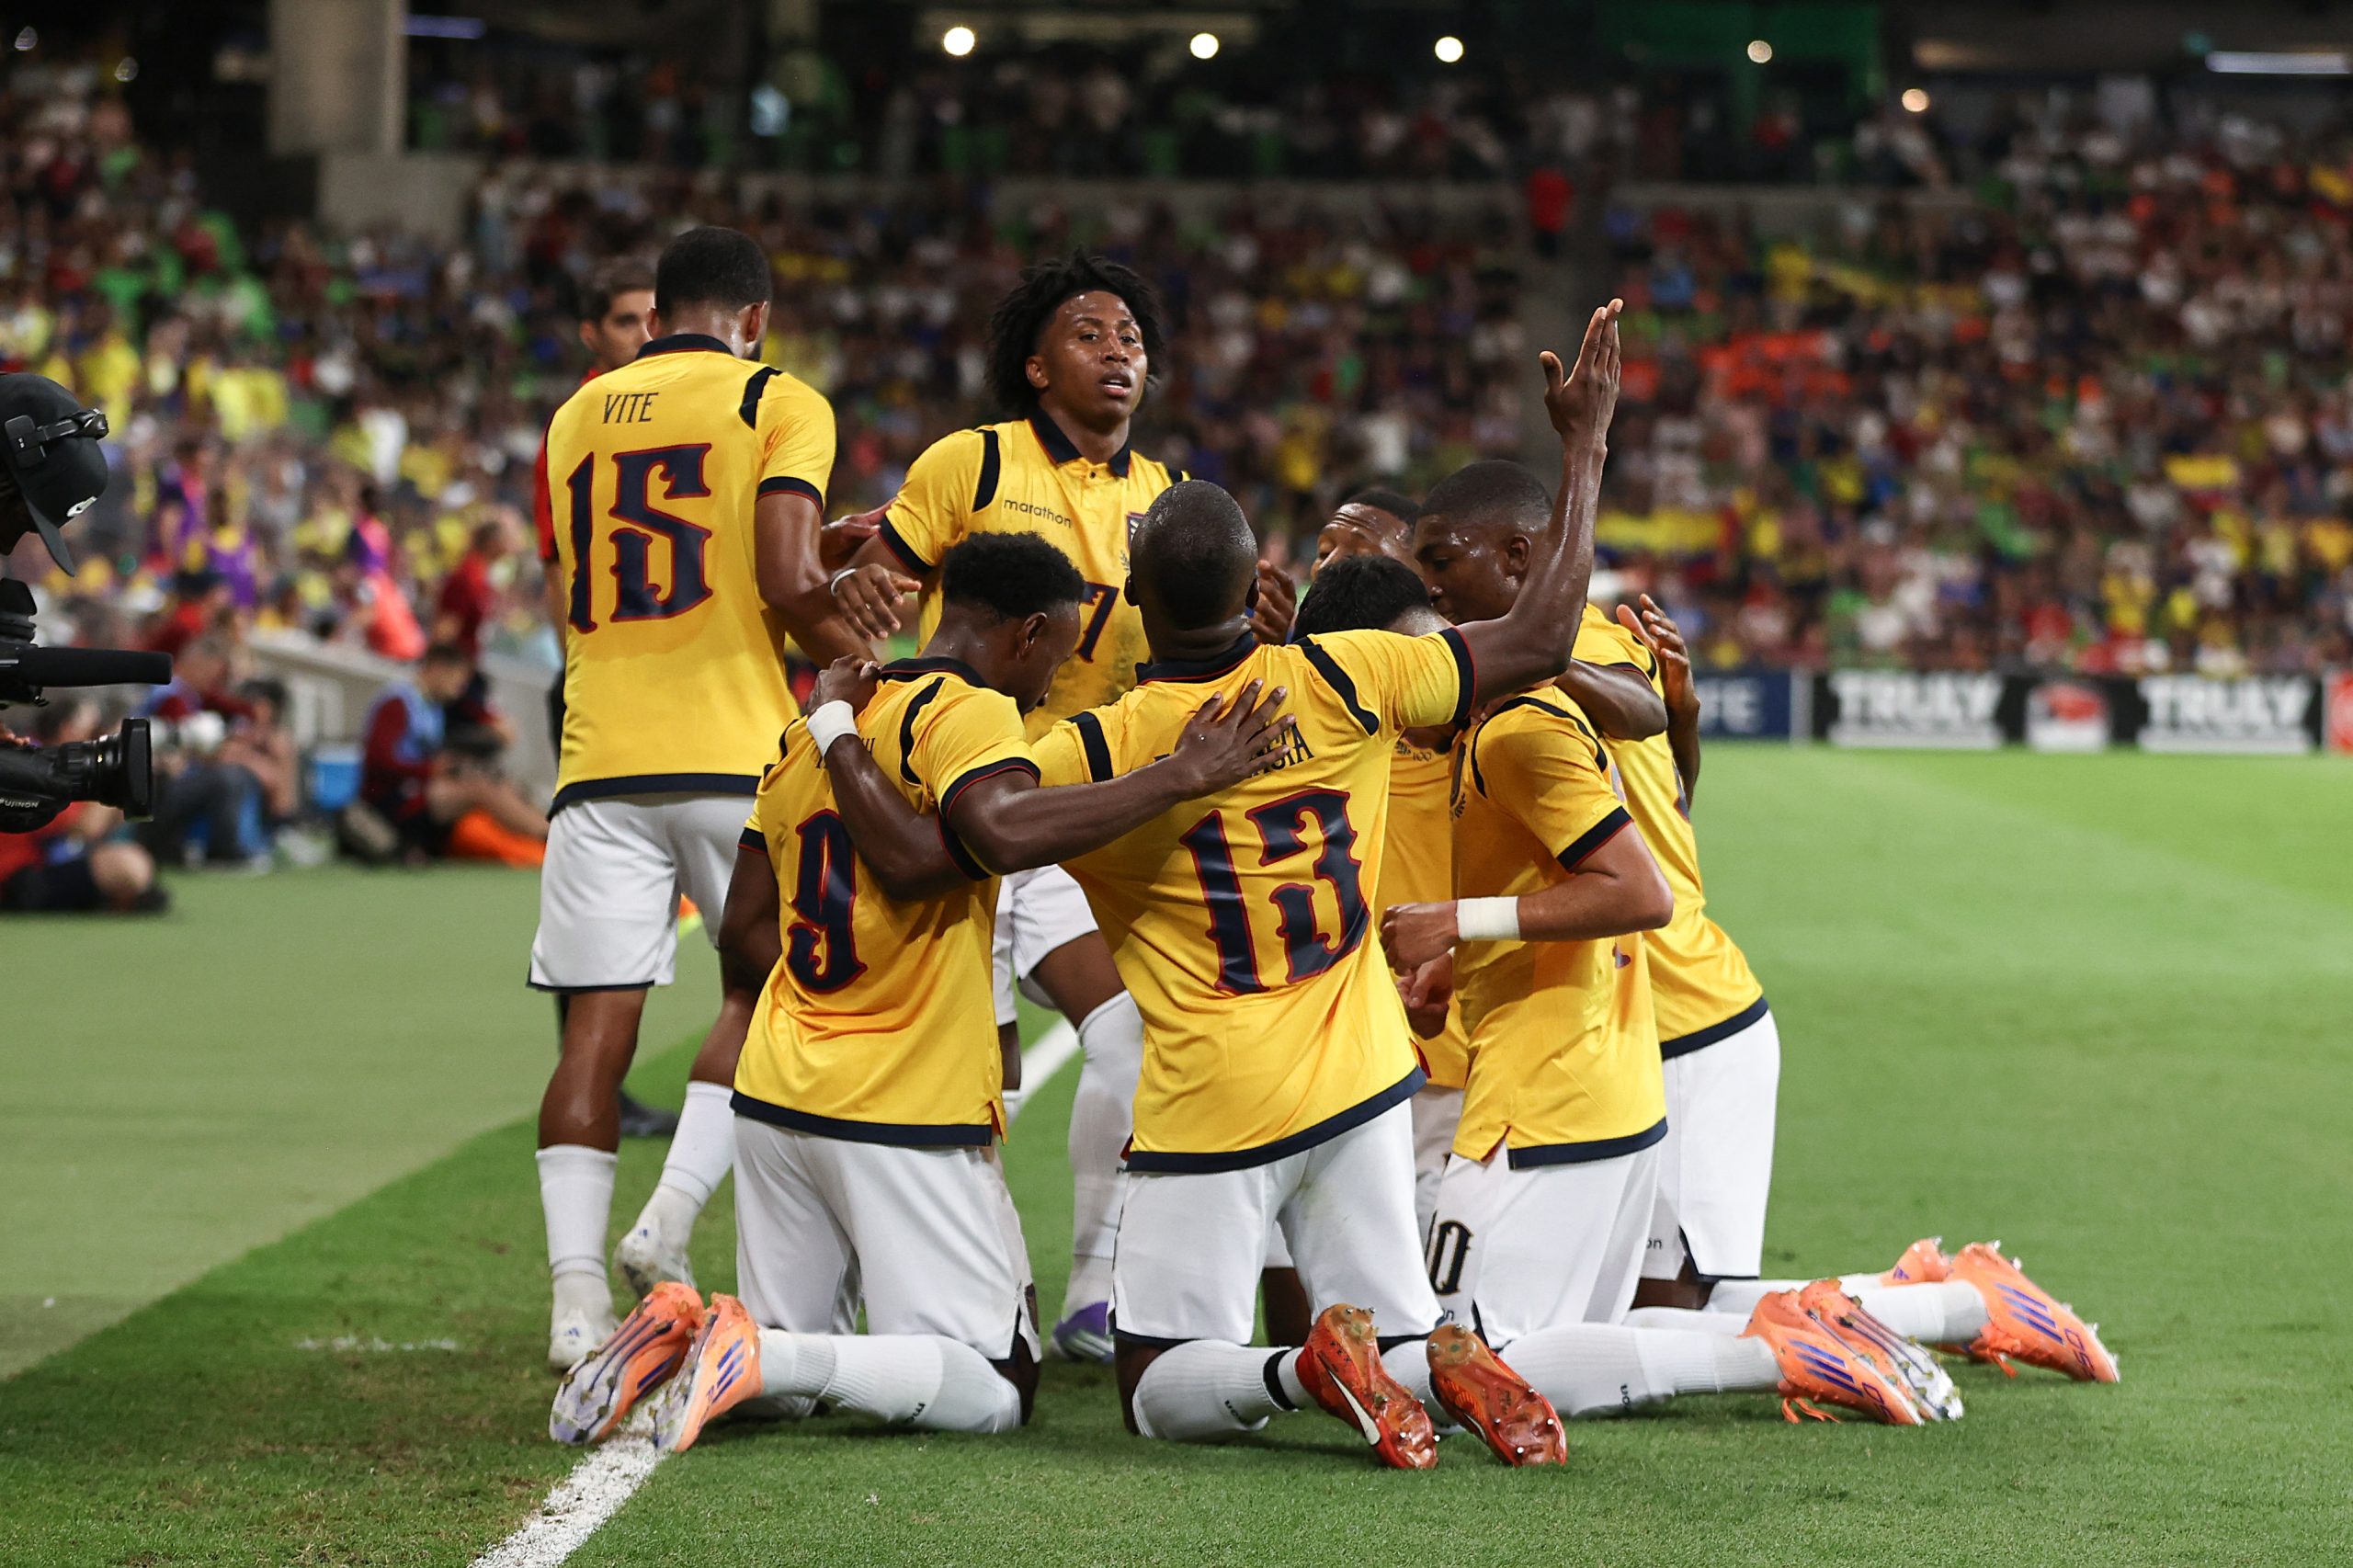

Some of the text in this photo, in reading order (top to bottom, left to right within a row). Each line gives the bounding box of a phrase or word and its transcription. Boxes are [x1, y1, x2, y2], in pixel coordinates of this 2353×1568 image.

[602, 392, 660, 425] VITE
[566, 442, 713, 634] 15
[1004, 498, 1074, 529] marathon
[787, 808, 869, 994] 9
[1178, 788, 1372, 996] 13
